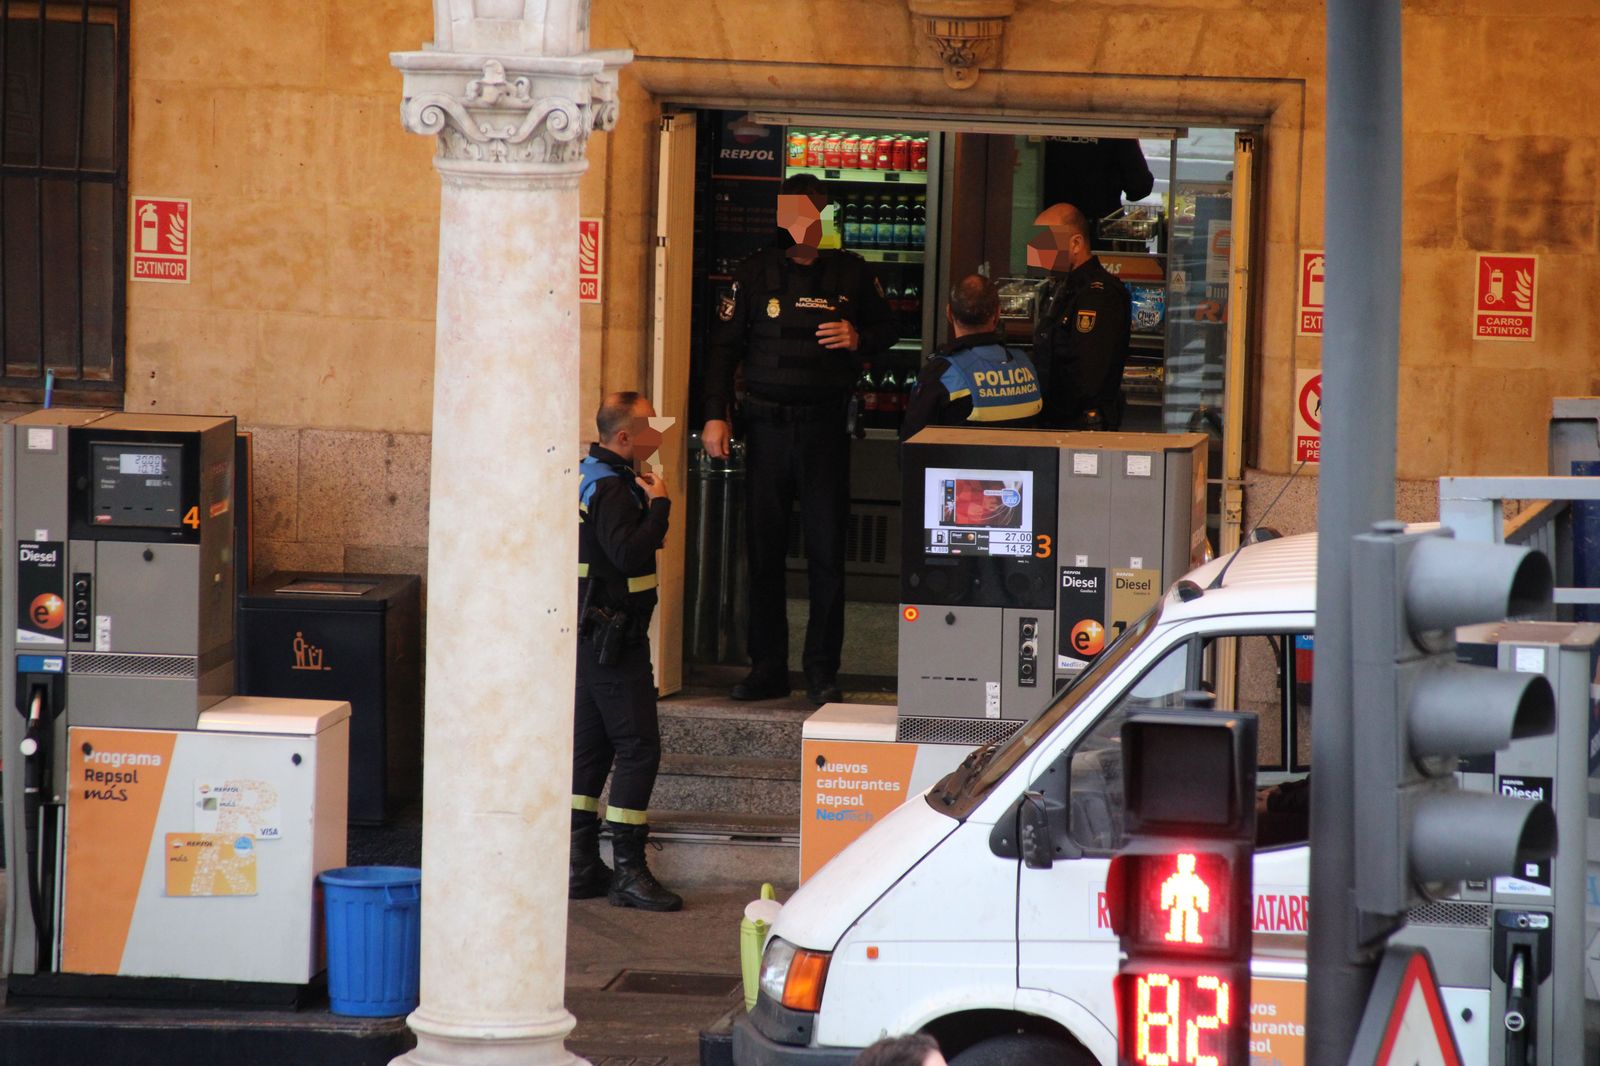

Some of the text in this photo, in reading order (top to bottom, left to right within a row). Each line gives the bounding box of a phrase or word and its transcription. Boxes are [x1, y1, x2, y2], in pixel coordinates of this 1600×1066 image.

[720, 149, 775, 160] REPSOL
[136, 261, 184, 276] EXTINTOR
[1486, 317, 1523, 326] CARRO
[1479, 326, 1529, 335] EXTINTOR
[973, 367, 1035, 387] POLICIA
[979, 383, 1038, 398] SALAMANCA
[183, 506, 200, 529] 4
[1035, 534, 1052, 558] 3
[20, 549, 57, 562] Diesel
[1062, 575, 1098, 588] Diesel
[1115, 578, 1151, 590] Diesel
[84, 750, 161, 768] Programa
[816, 762, 868, 774] Nuevos
[84, 768, 138, 785] Repsol
[816, 777, 901, 791] carburantes
[84, 784, 128, 801] más
[1502, 785, 1544, 801] Diesel
[816, 793, 864, 808] Repsol
[260, 828, 279, 836] VISA
[1137, 973, 1230, 1066] 82
